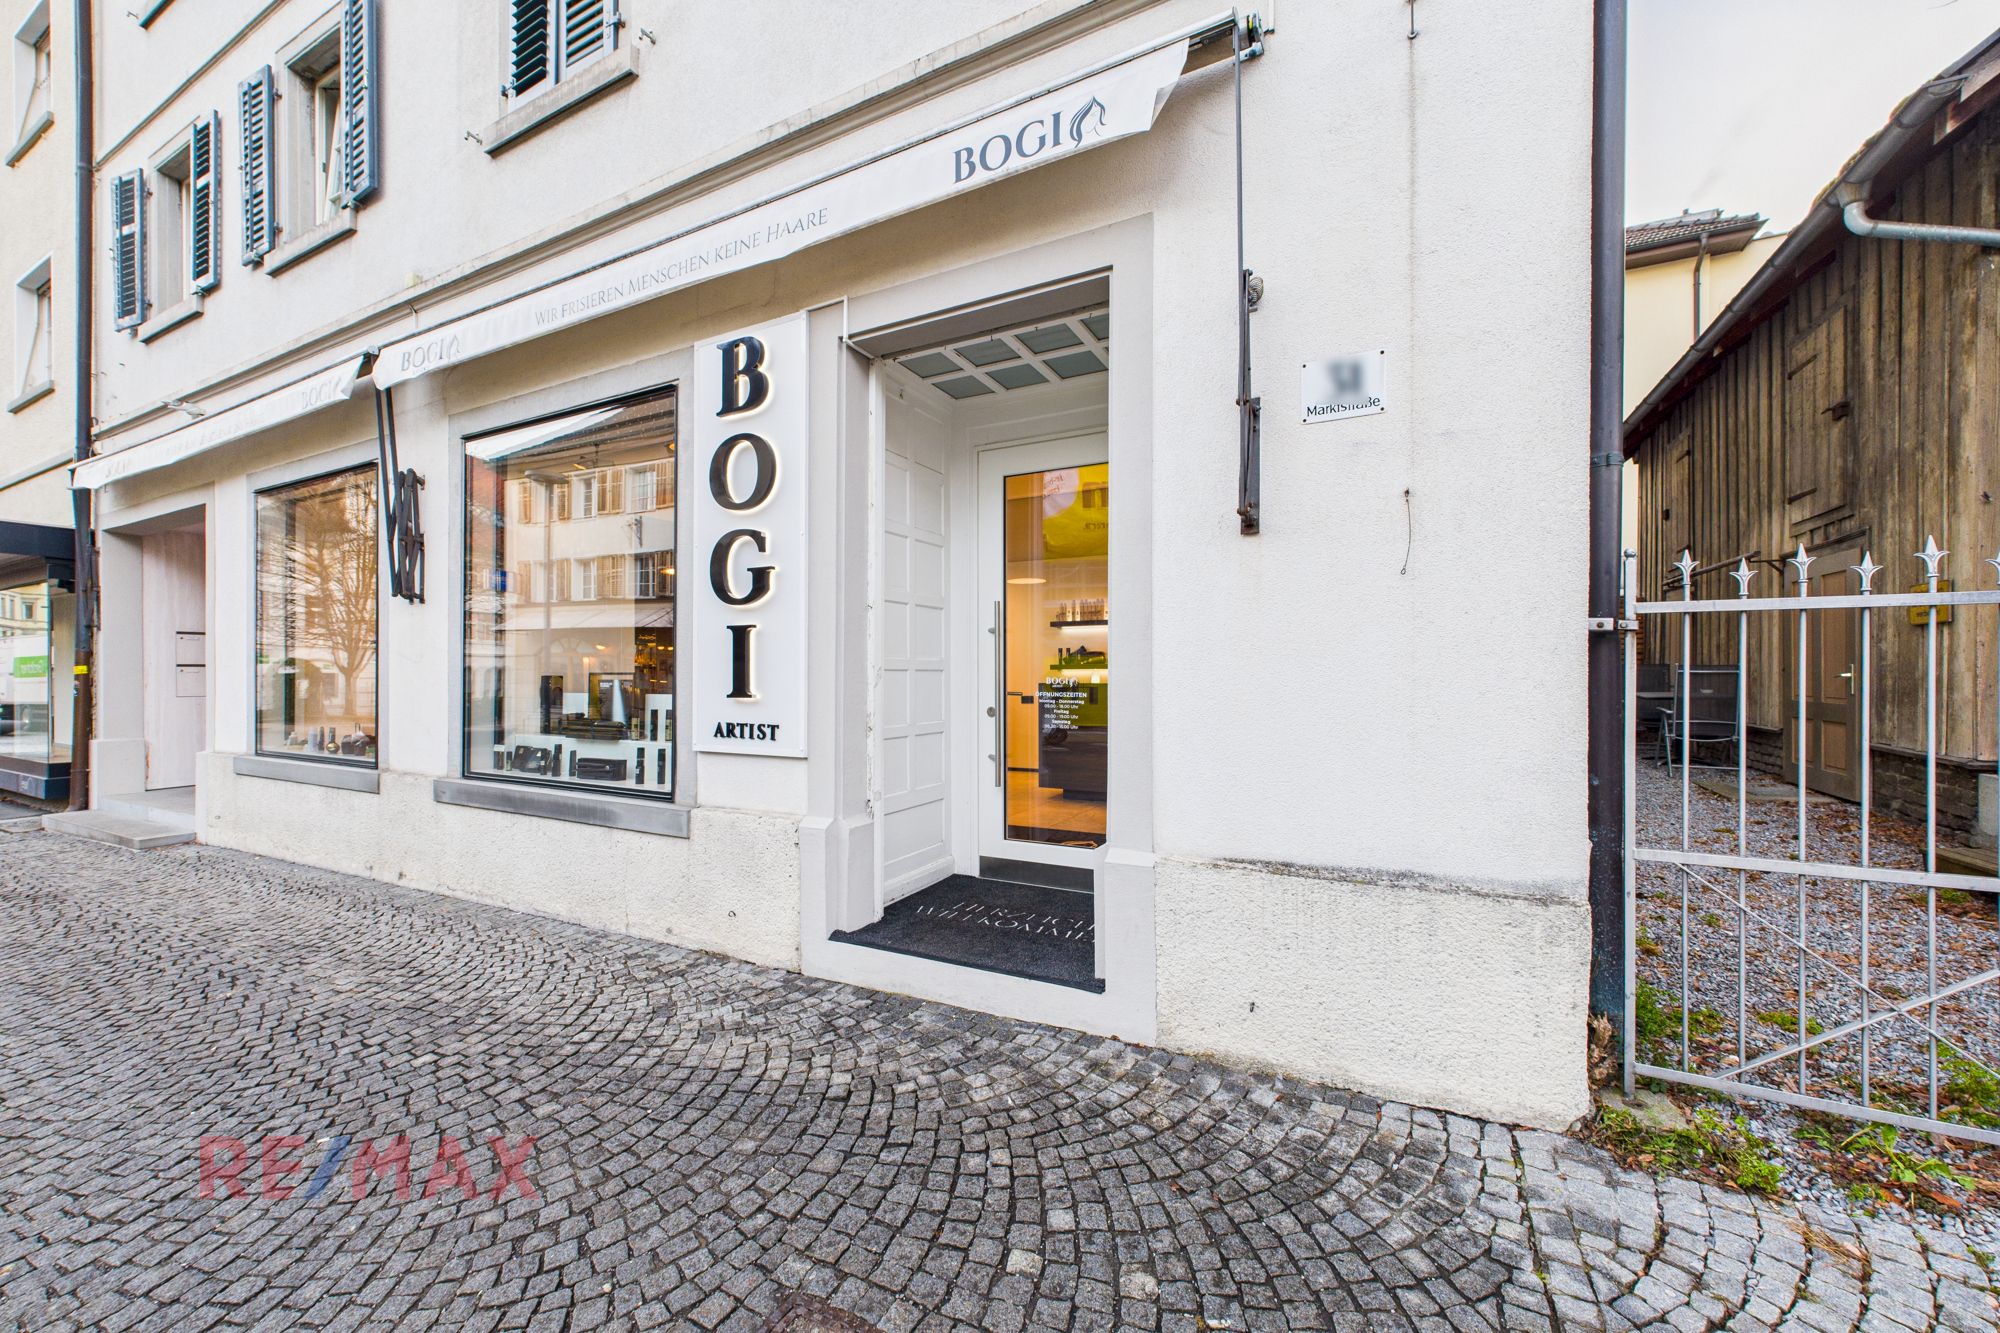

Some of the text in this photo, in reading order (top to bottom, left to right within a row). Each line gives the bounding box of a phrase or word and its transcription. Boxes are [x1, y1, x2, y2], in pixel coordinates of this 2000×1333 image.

[953, 111, 1063, 183] BOGI
[534, 207, 830, 326] WIR FRISIEREN MENSCHEN KEINE HAARE
[401, 338, 444, 373] BOGI
[708, 335, 778, 700] BOGI
[1046, 676, 1069, 685] BOGI
[713, 721, 780, 741] ARTIST
